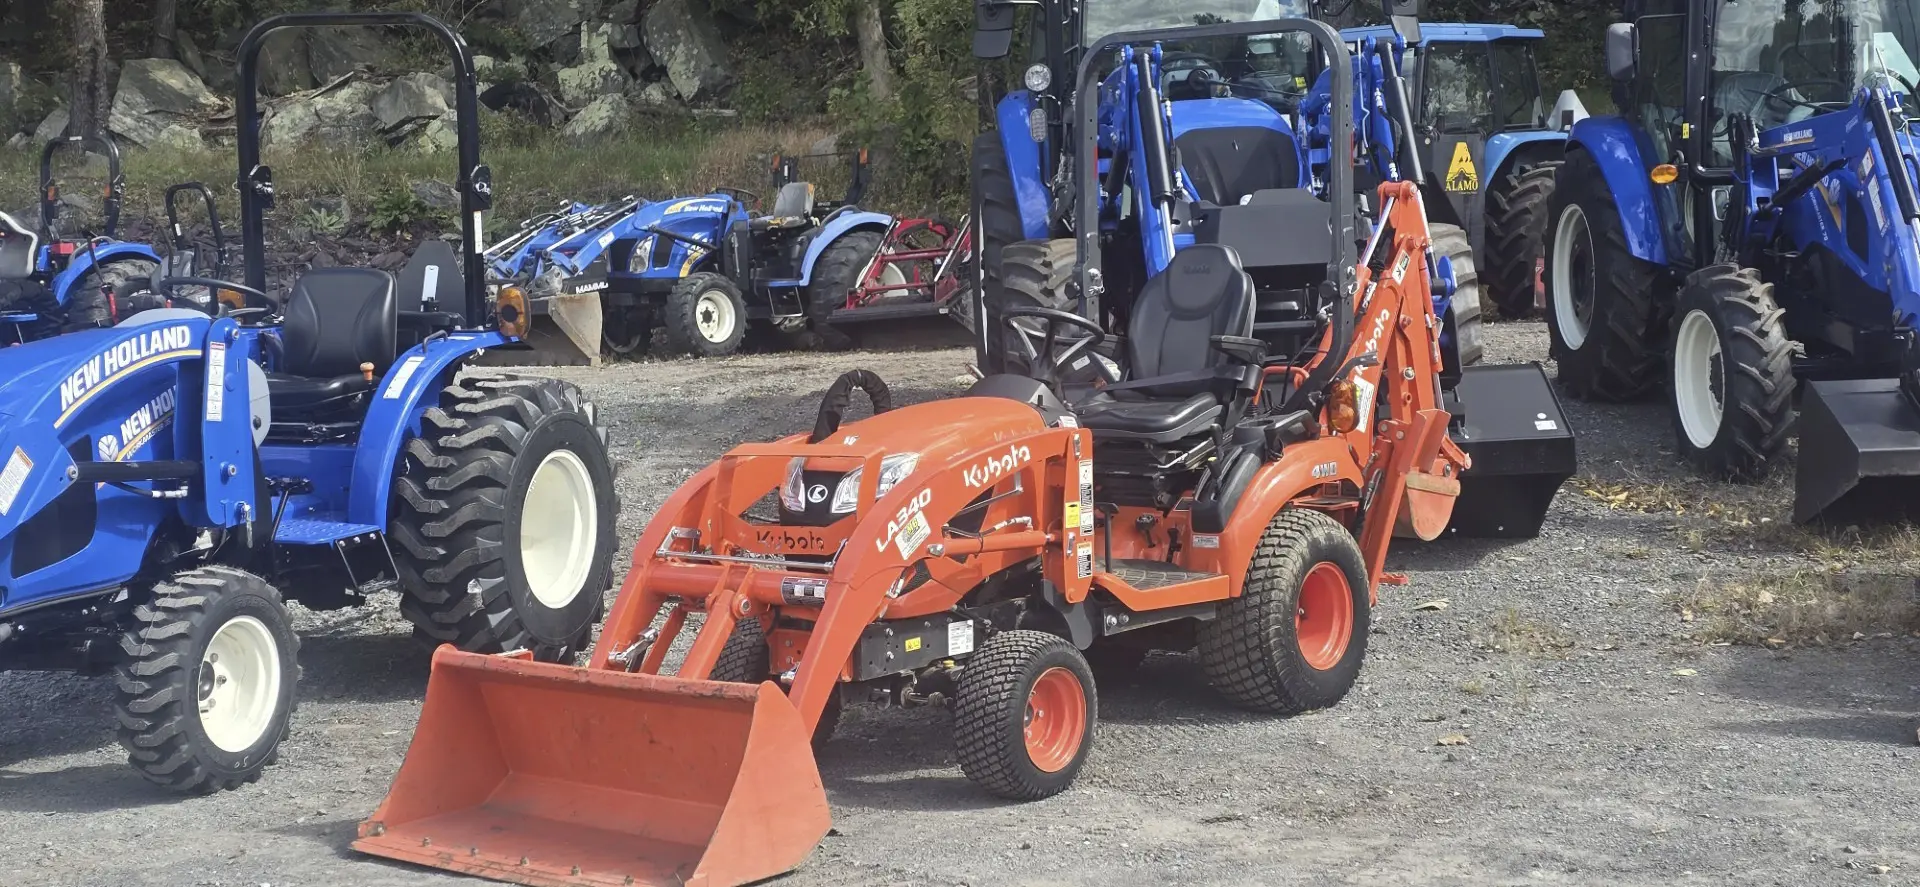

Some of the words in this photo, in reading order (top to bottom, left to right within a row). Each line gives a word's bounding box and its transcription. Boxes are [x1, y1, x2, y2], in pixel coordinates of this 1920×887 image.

[1445, 180, 1479, 192] ALAMO
[60, 355, 100, 412] NEW
[104, 325, 191, 376] HOLLAND
[120, 403, 151, 446] NEW
[963, 444, 1031, 488] Kubota
[1311, 461, 1337, 479] 4WD
[757, 531, 824, 551] Kubota
[876, 487, 931, 553] LA340
